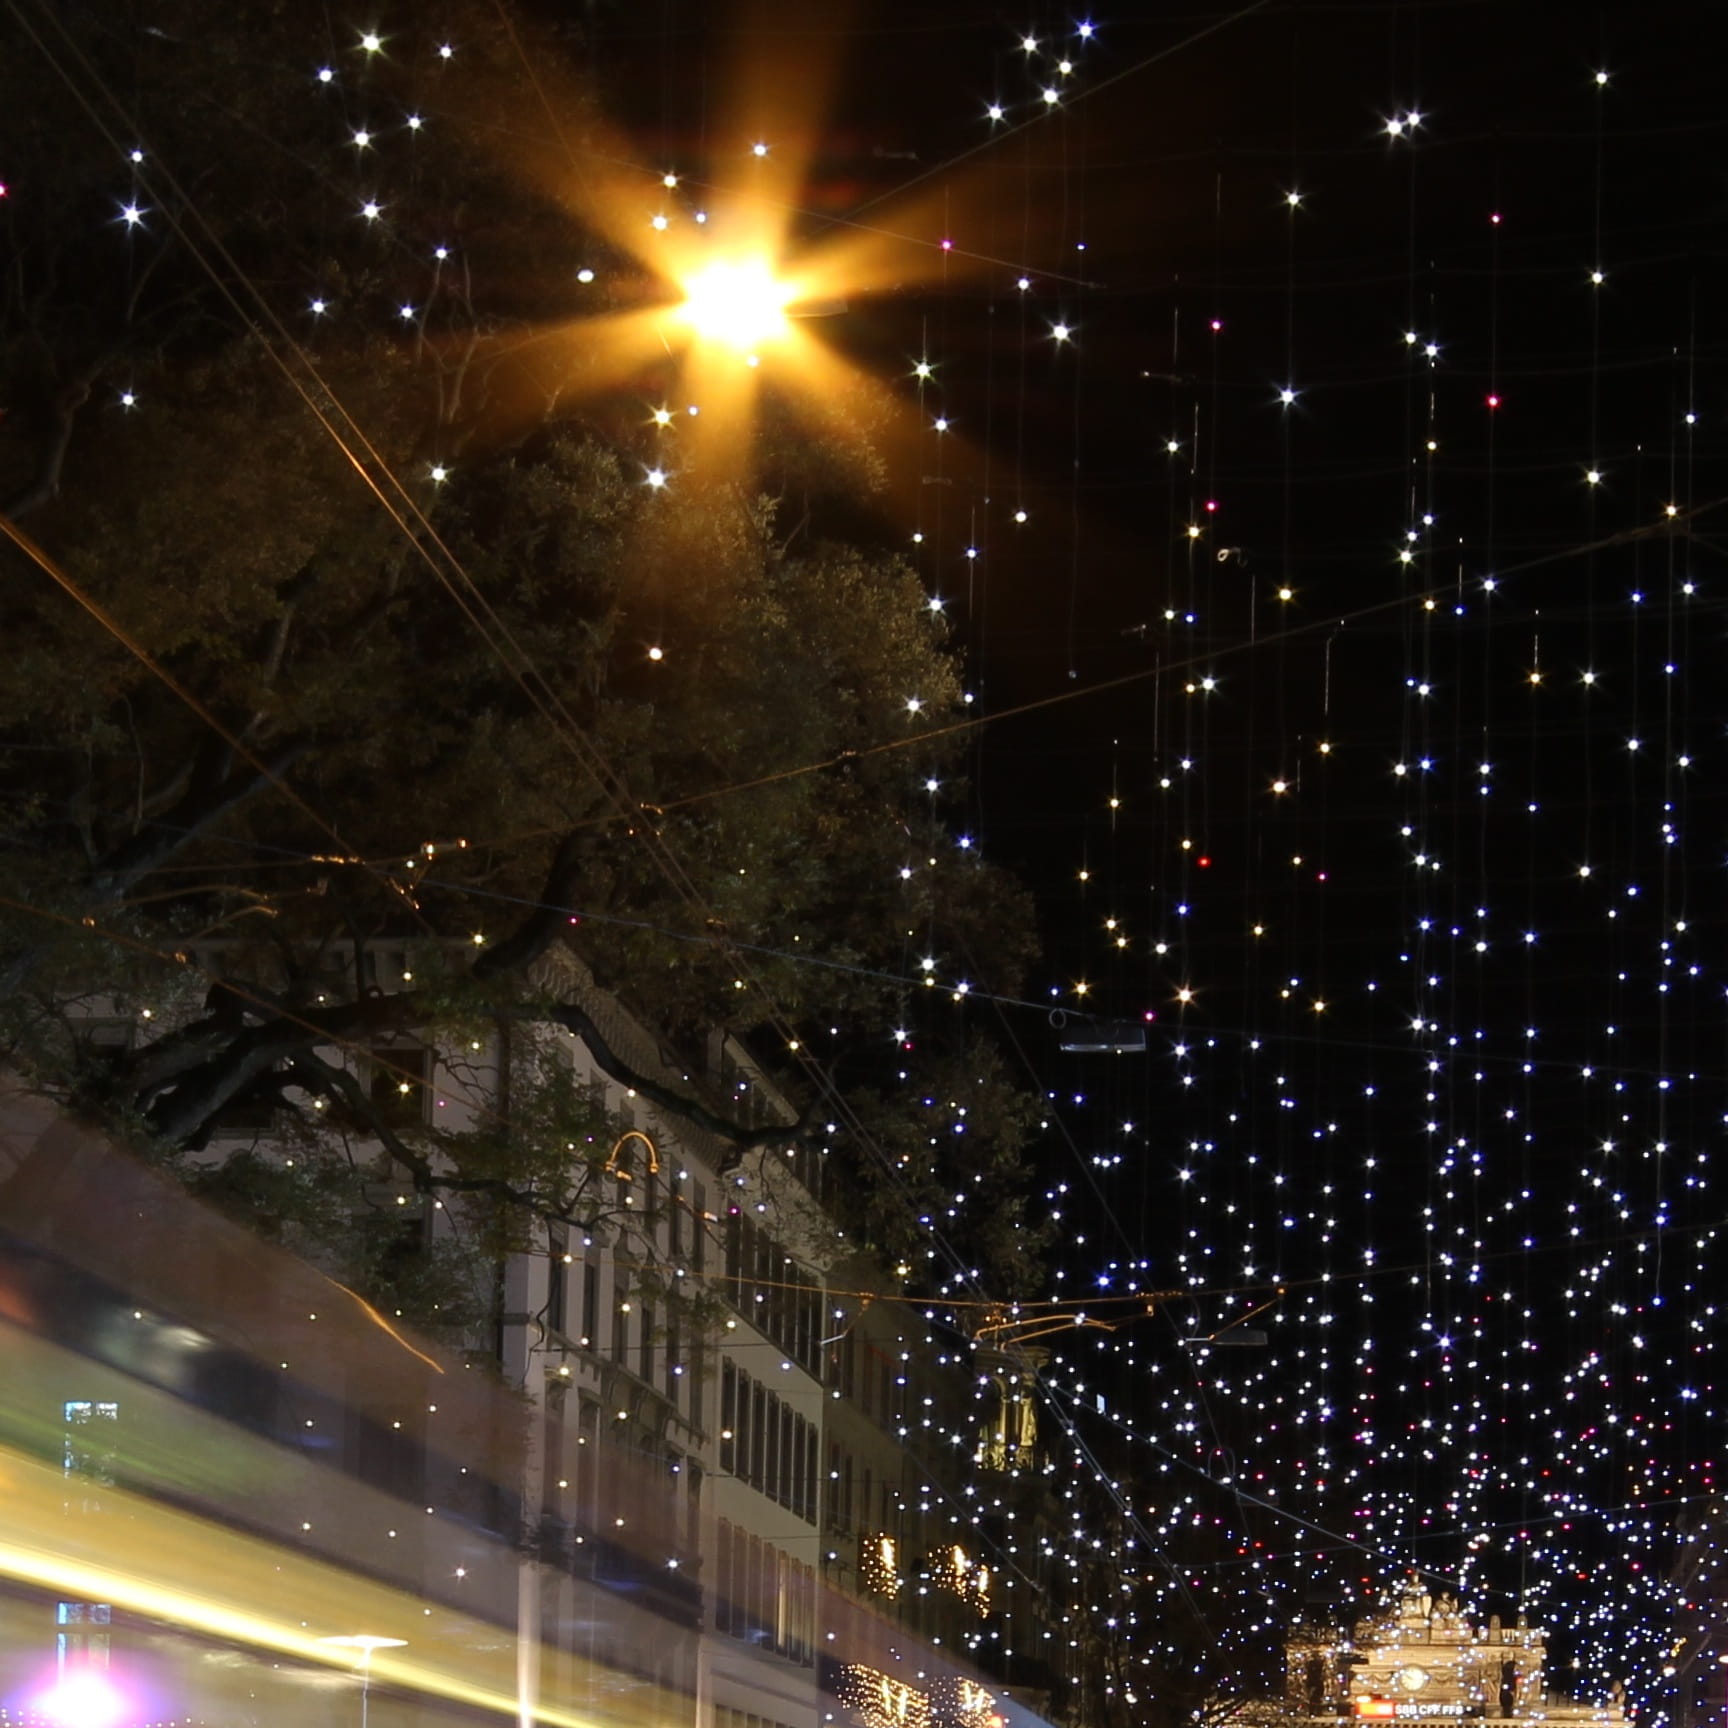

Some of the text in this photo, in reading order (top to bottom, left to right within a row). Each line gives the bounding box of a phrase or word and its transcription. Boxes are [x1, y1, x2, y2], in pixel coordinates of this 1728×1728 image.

[1395, 1704, 1464, 1716] SBB CFF FFS
